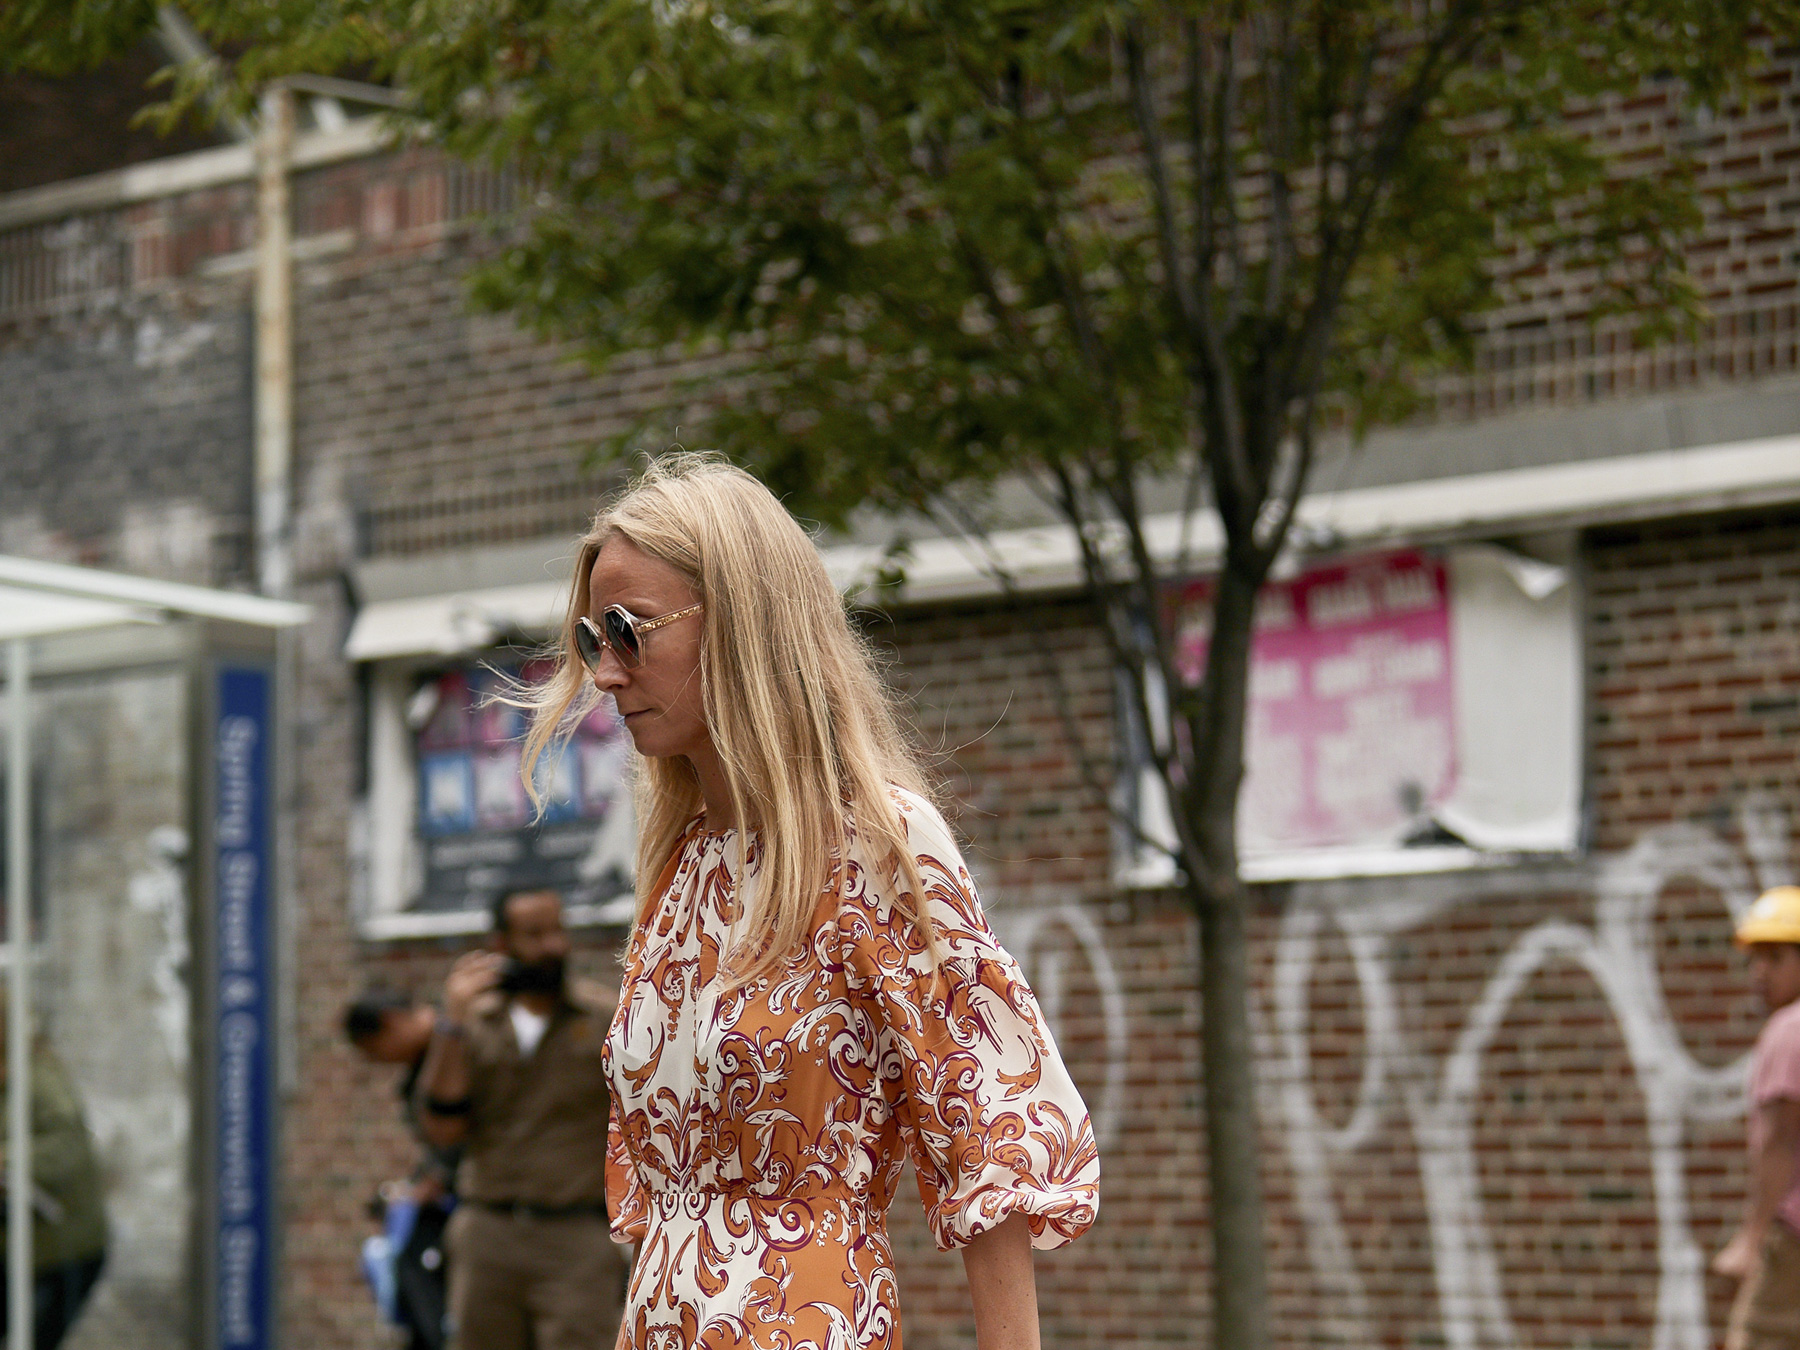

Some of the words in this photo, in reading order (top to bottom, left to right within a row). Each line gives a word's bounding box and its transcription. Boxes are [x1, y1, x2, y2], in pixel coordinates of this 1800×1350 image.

[213, 715, 258, 847] Spring
[219, 852, 258, 971] Street
[219, 975, 258, 1007] &
[218, 1011, 257, 1215] Greenwich
[218, 1225, 257, 1344] Street
